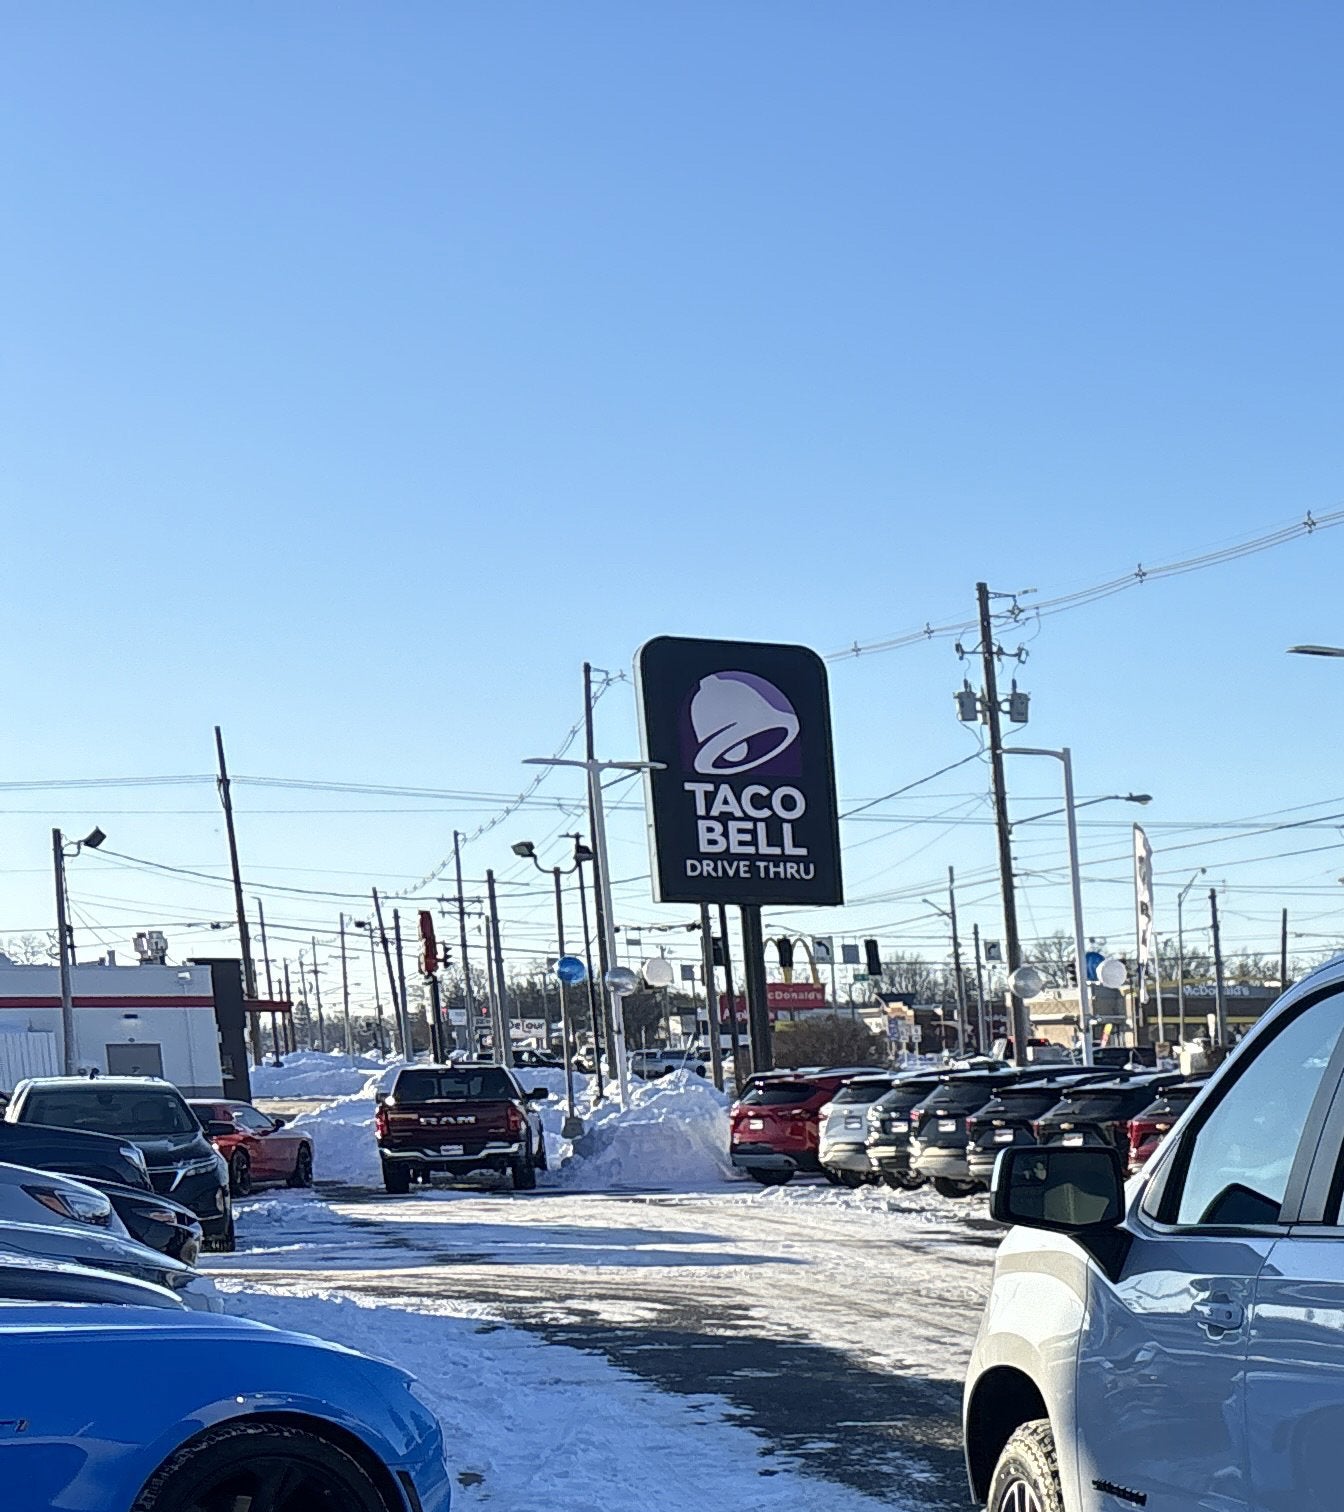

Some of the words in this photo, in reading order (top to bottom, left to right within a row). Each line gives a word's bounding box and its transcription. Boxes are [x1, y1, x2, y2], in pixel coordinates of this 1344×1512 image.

[684, 782, 806, 820] TACO
[697, 819, 808, 856] BELL
[686, 860, 750, 878] DRIVE
[755, 861, 815, 880] THRU
[767, 990, 822, 1000] cDonald's
[1182, 985, 1249, 996] McDoald's
[419, 1115, 477, 1126] RAM
